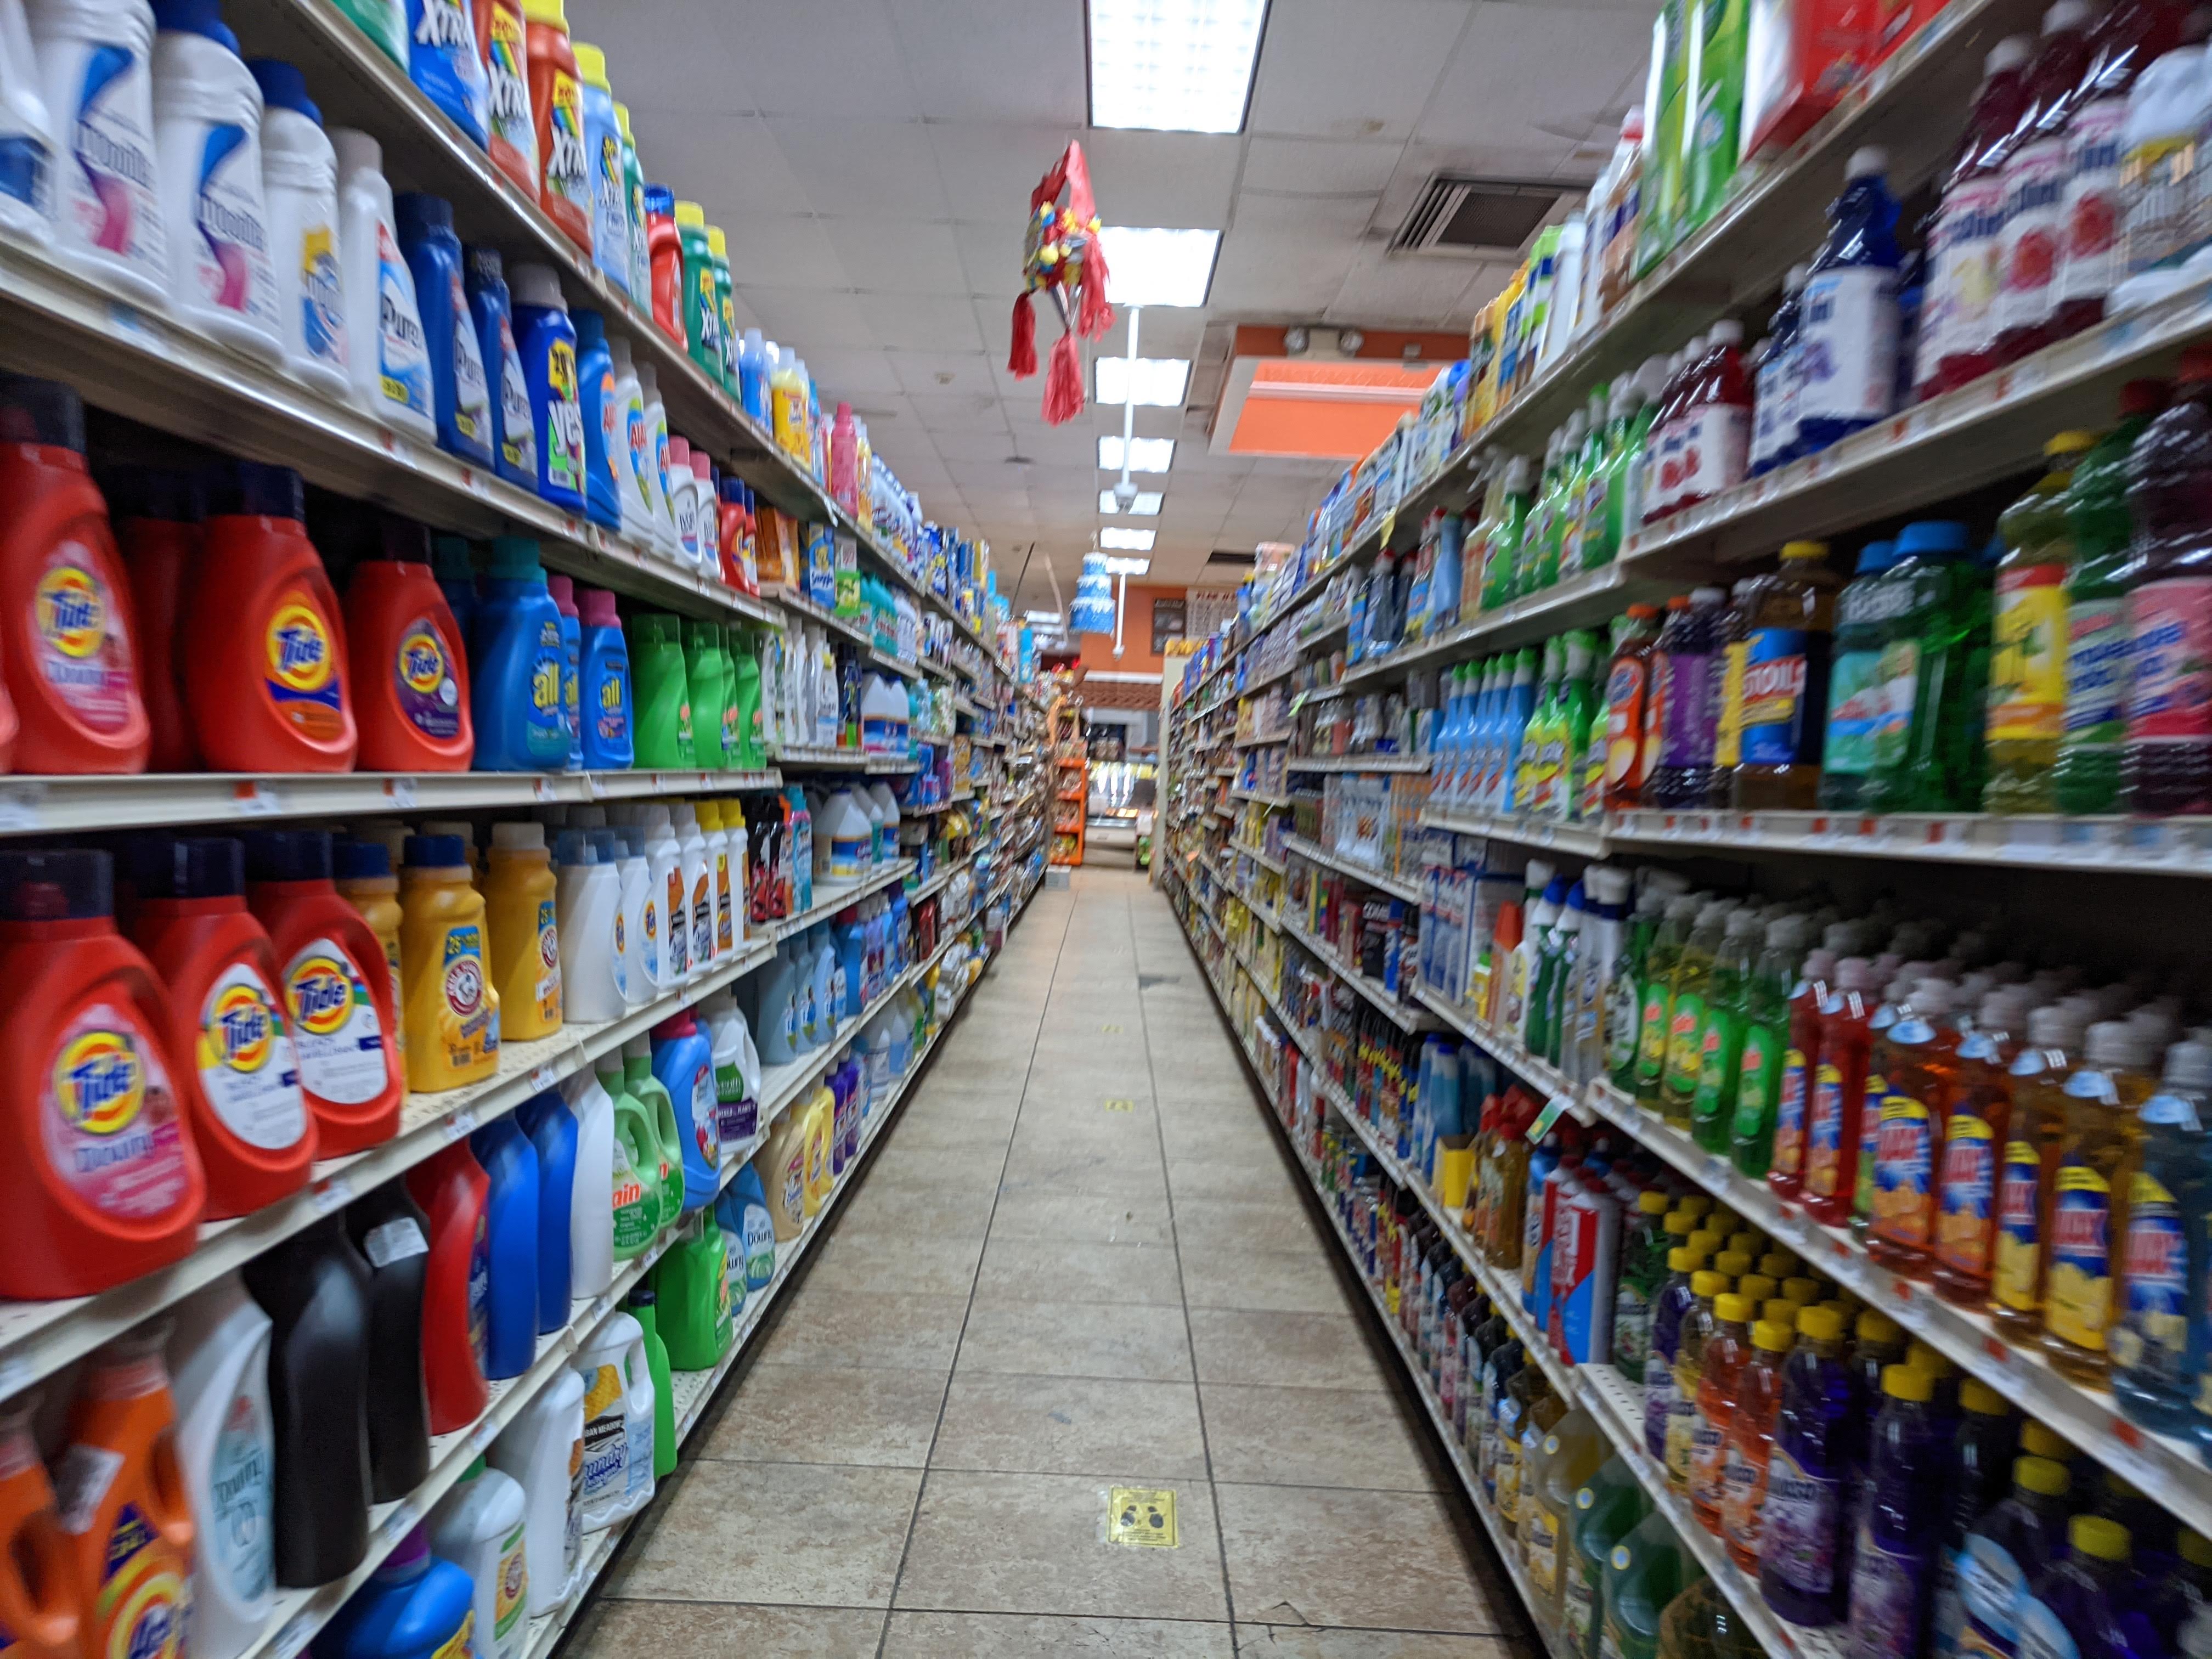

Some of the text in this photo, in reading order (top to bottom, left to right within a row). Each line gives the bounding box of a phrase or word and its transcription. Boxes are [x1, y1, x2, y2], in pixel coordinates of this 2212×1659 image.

[533, 663, 560, 709] all
[602, 678, 620, 708] all
[613, 1183, 641, 1210] ain
